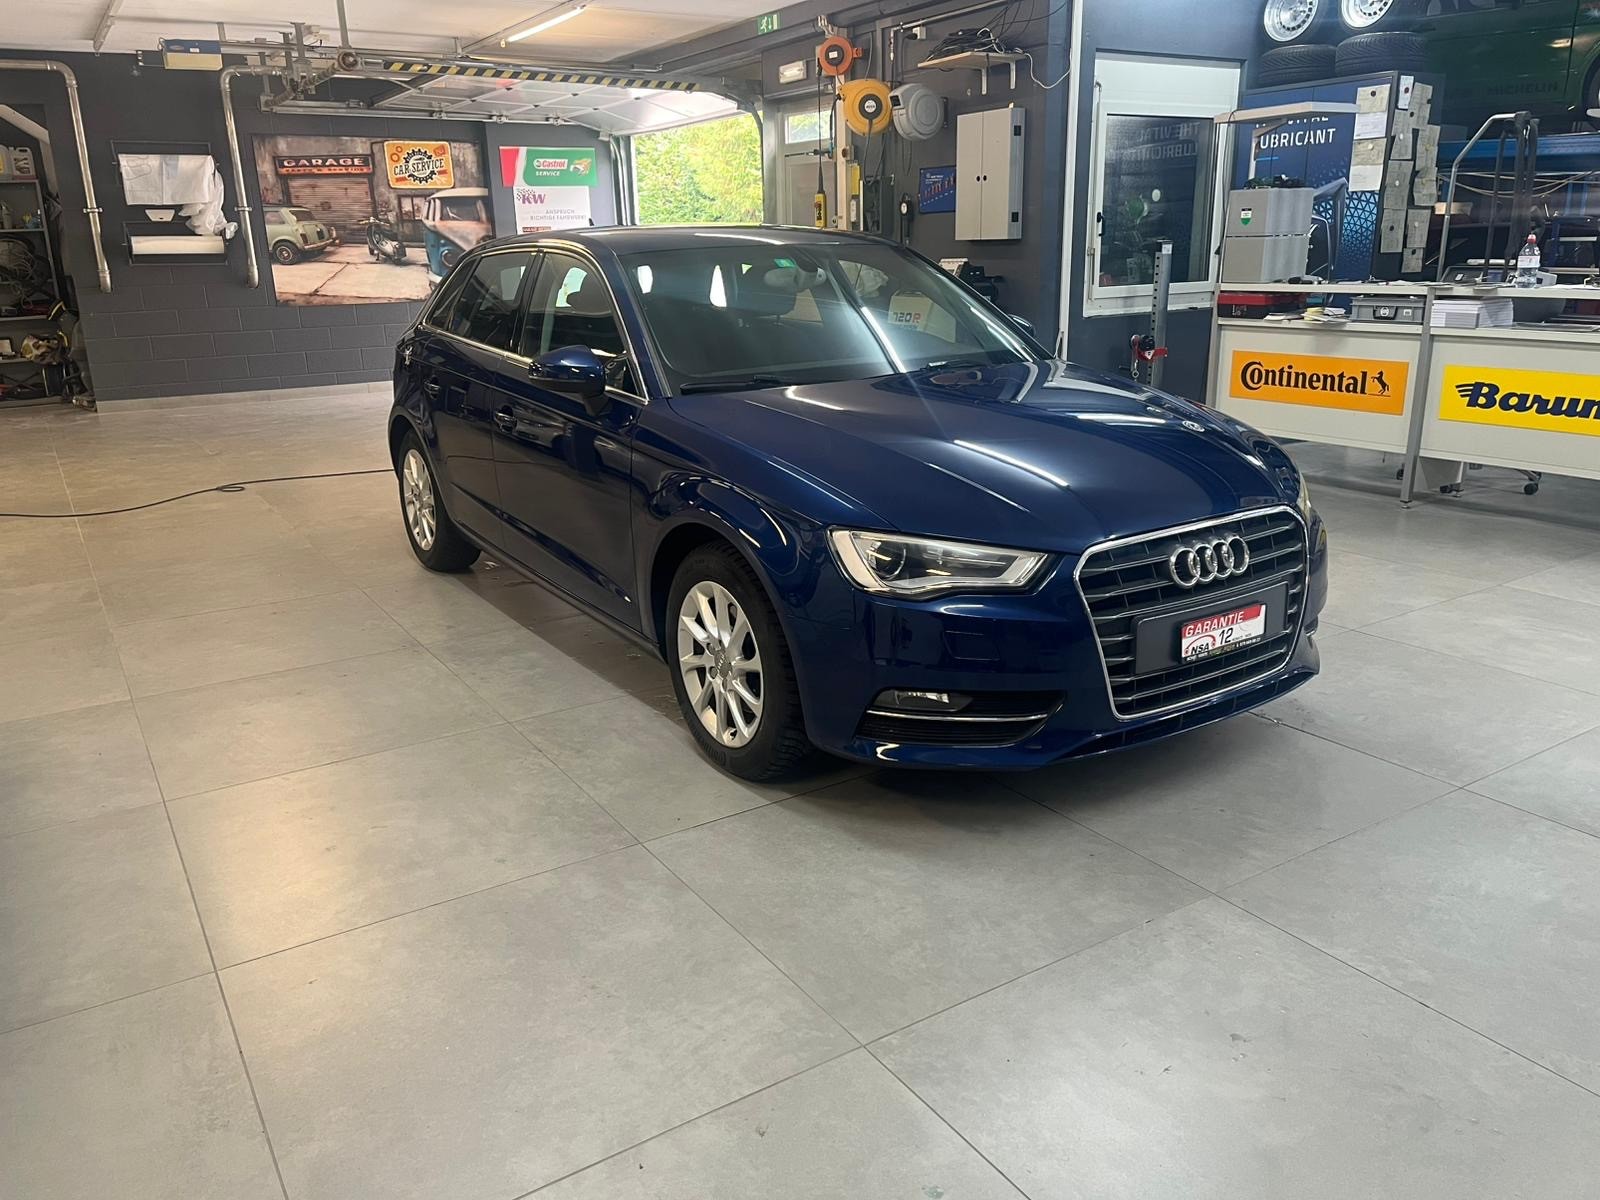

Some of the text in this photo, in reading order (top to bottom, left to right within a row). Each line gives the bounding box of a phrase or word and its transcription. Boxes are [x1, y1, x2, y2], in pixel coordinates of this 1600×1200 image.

[1488, 81, 1558, 96] MICHELIN
[1260, 128, 1336, 149] UBRICANT
[283, 158, 365, 167] GARAGE
[394, 158, 445, 176] CAR SERVICE
[542, 159, 566, 168] Castrol
[521, 193, 546, 205] KW
[1240, 360, 1368, 395] Continental
[1185, 611, 1245, 637] GARANTIE
[1219, 627, 1234, 645] 12
[1191, 642, 1210, 655] NSA
